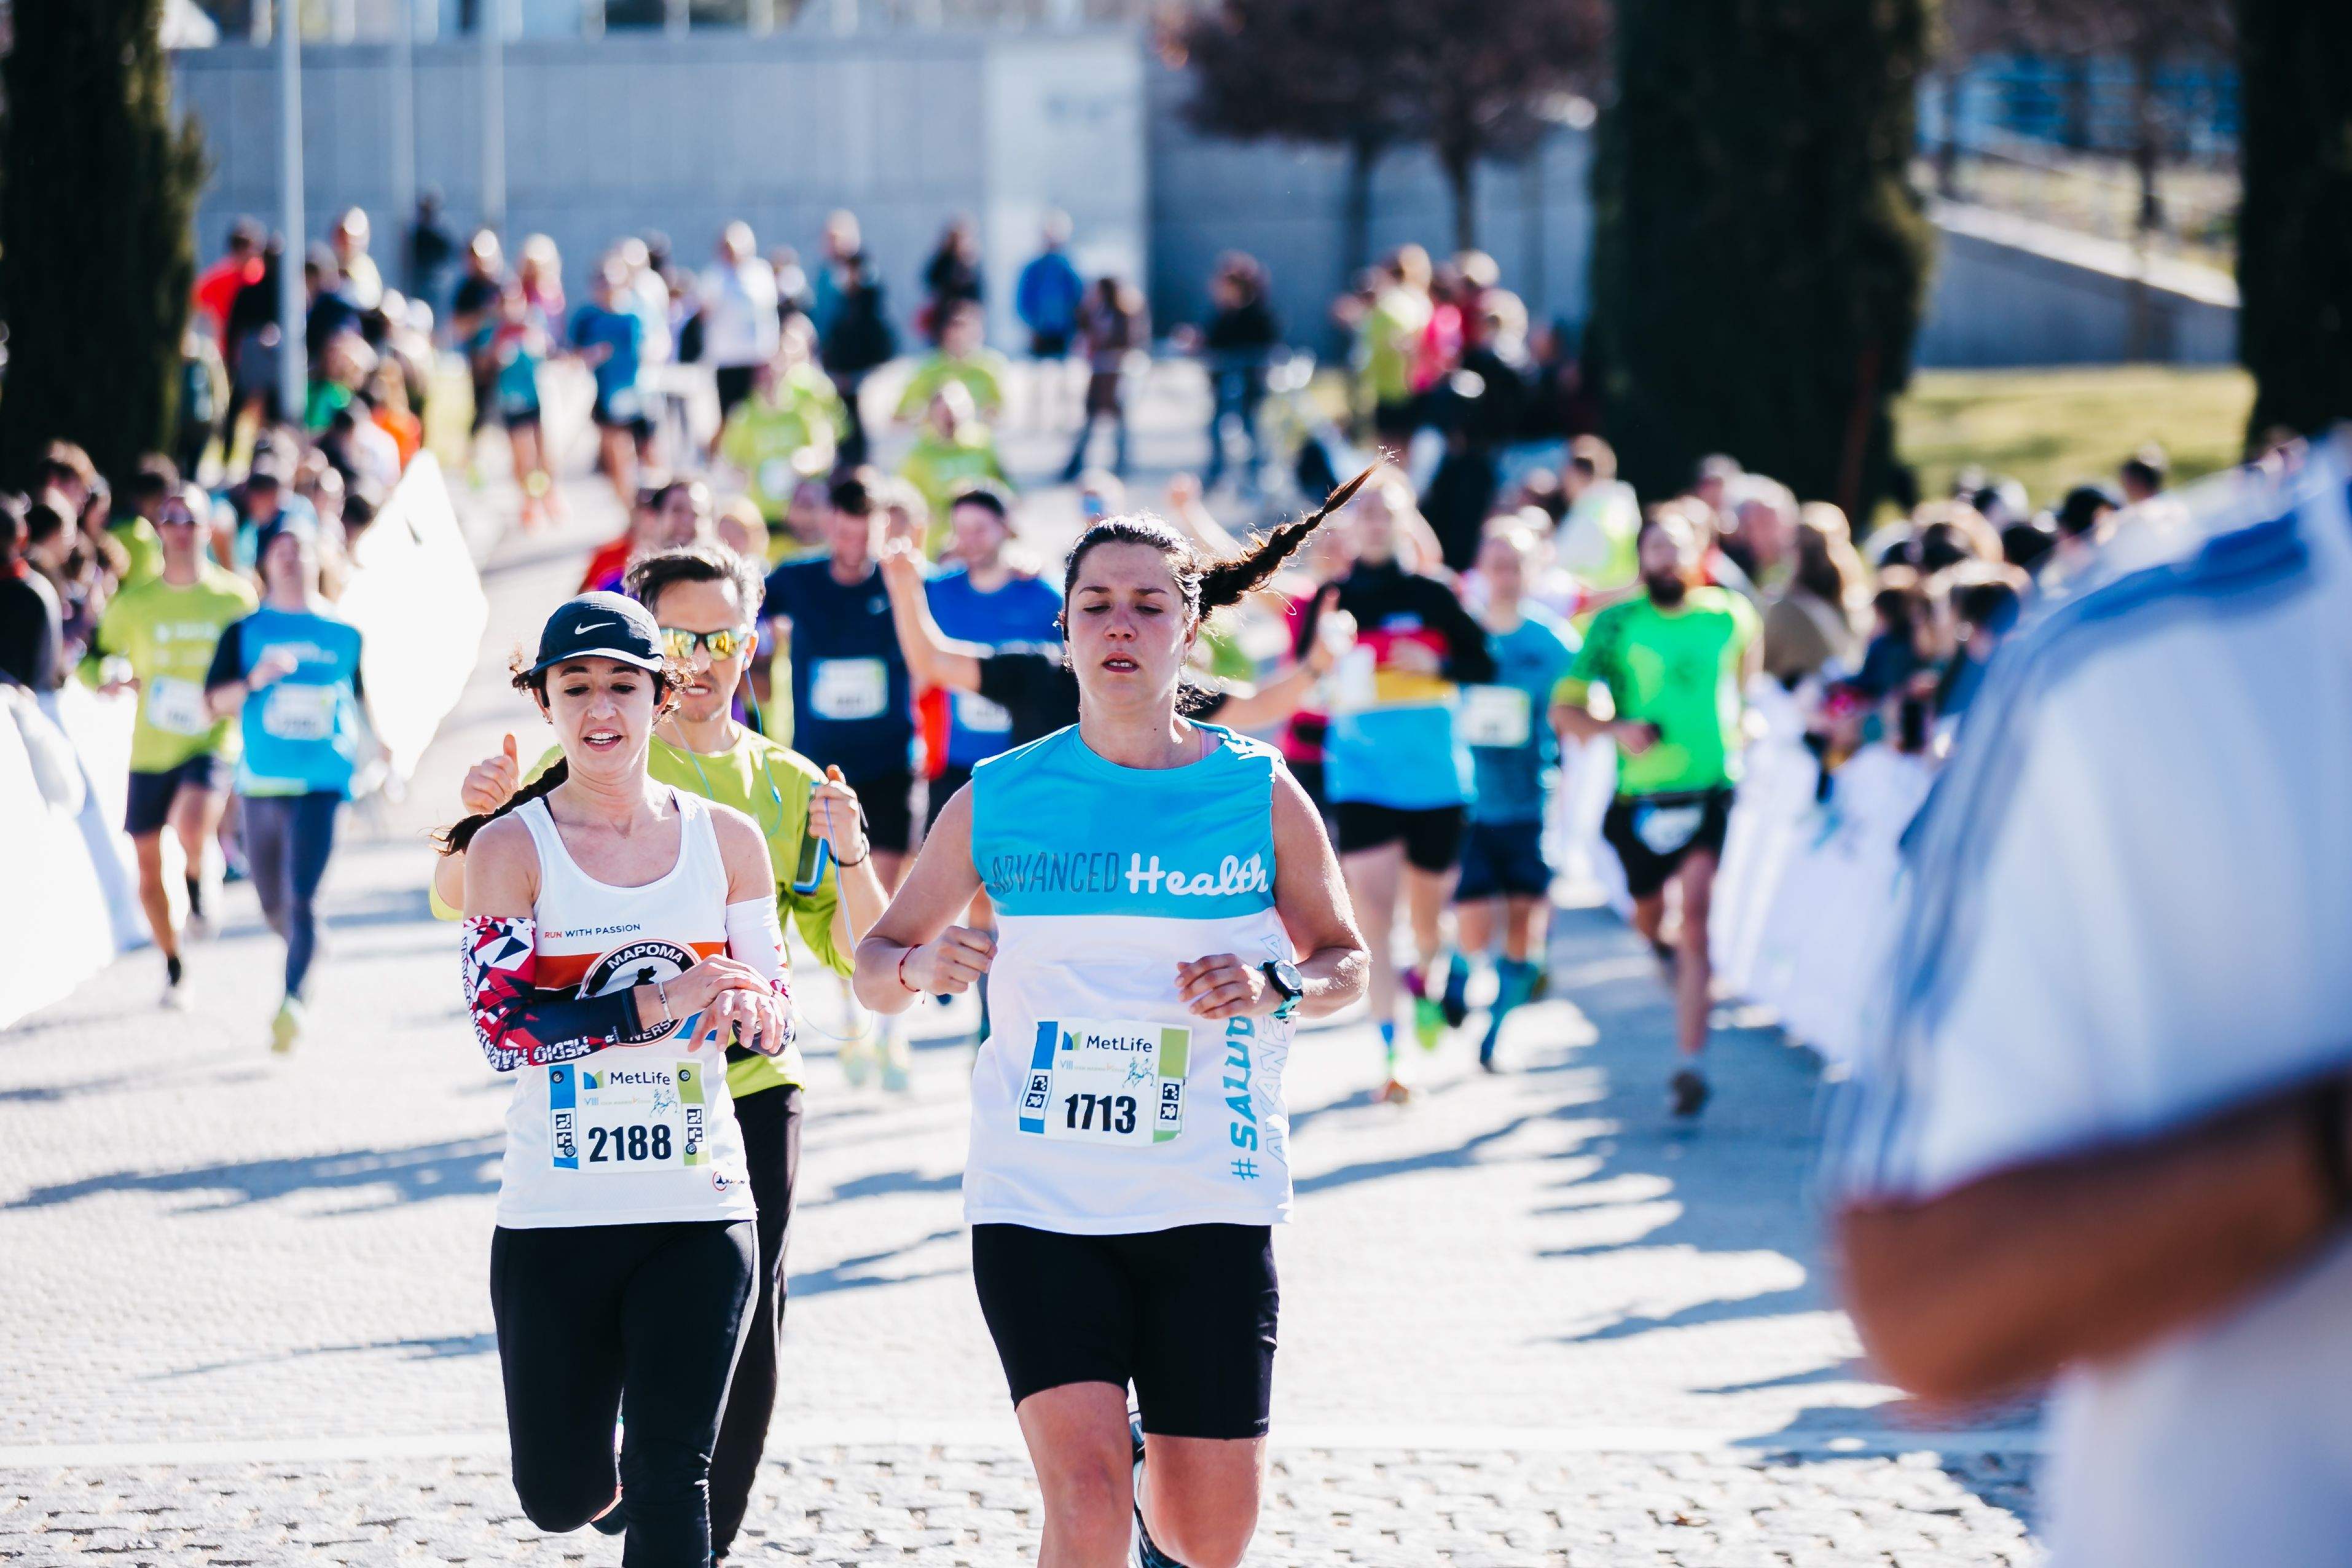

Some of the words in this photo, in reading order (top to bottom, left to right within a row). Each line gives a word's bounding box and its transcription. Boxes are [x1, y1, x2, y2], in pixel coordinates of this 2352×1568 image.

[992, 852, 1119, 895] ADVANCED
[1124, 852, 1269, 896] Health
[565, 928, 592, 938] WITH
[595, 923, 641, 935] PASSION
[607, 944, 683, 970] MAPOMA
[1086, 1035, 1153, 1053] MetLife
[1060, 1060, 1073, 1071] VIII
[610, 1072, 671, 1086] MetLife
[584, 1097, 599, 1106] VIII
[1064, 1094, 1137, 1134] 1713
[588, 1124, 672, 1162] 2188
